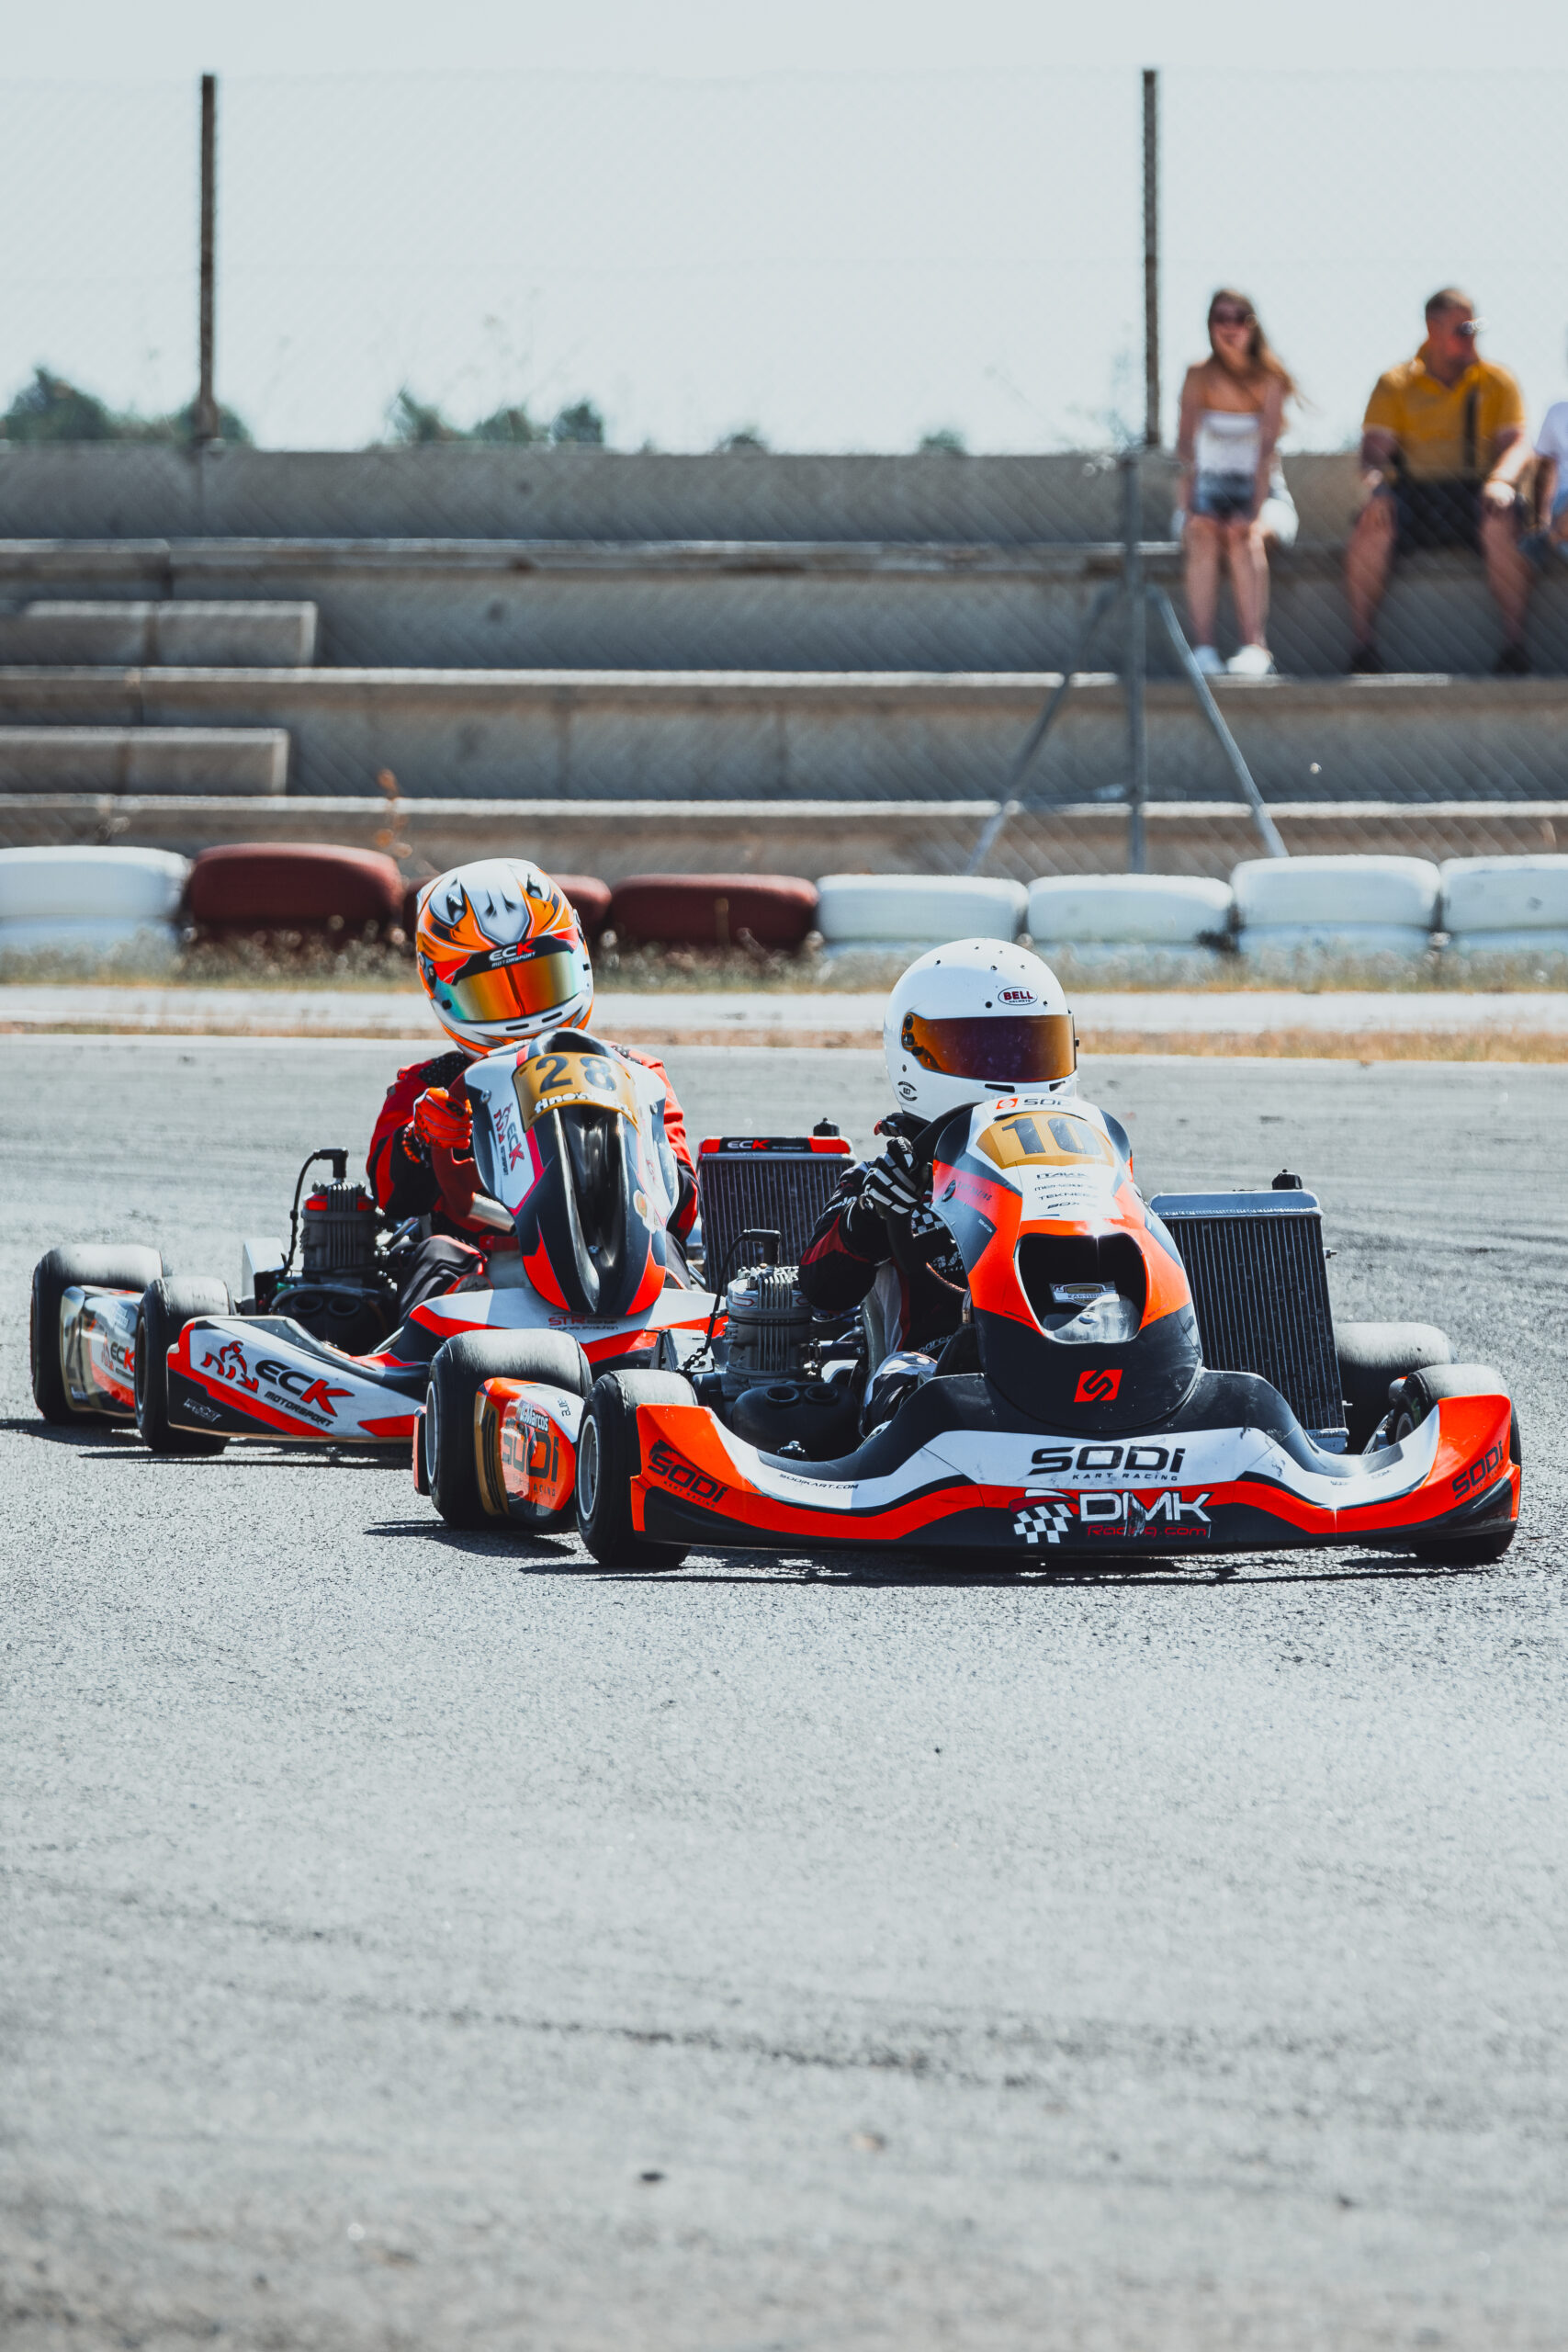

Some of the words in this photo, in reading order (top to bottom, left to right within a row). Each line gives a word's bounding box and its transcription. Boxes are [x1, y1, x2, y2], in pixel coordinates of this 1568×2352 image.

[489, 939, 536, 961] ECK
[491, 951, 536, 968] MOTORSPORT
[1003, 990, 1034, 1001] BELL
[536, 1055, 616, 1093] 28
[507, 1122, 525, 1171] ECK
[727, 1139, 771, 1149] ECK
[1002, 1117, 1102, 1155] 10
[110, 1342, 135, 1373] ECK
[255, 1360, 355, 1417] ECK
[264, 1391, 334, 1427] MOTORSPORT
[1027, 1445, 1186, 1476] SODI
[1452, 1441, 1503, 1500] SODI
[648, 1453, 729, 1503] SODI
[779, 1474, 859, 1489] SODIKART.COM
[1122, 1473, 1178, 1481] RACING
[1077, 1491, 1213, 1522] DMK
